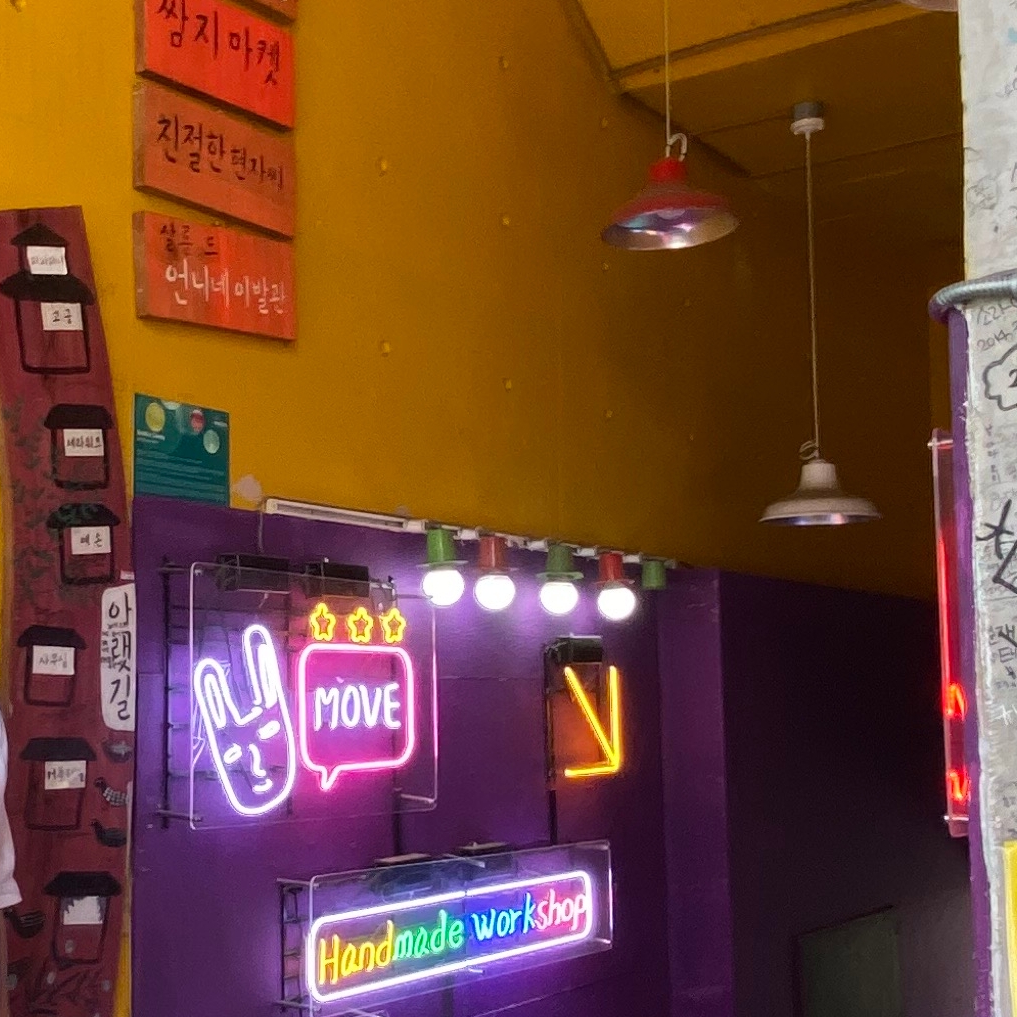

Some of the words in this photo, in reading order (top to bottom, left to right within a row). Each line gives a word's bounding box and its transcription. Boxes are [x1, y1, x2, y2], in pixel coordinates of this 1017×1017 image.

[313, 682, 402, 732] MOVE
[318, 909, 464, 986] Handmade
[470, 889, 589, 942] workshop
